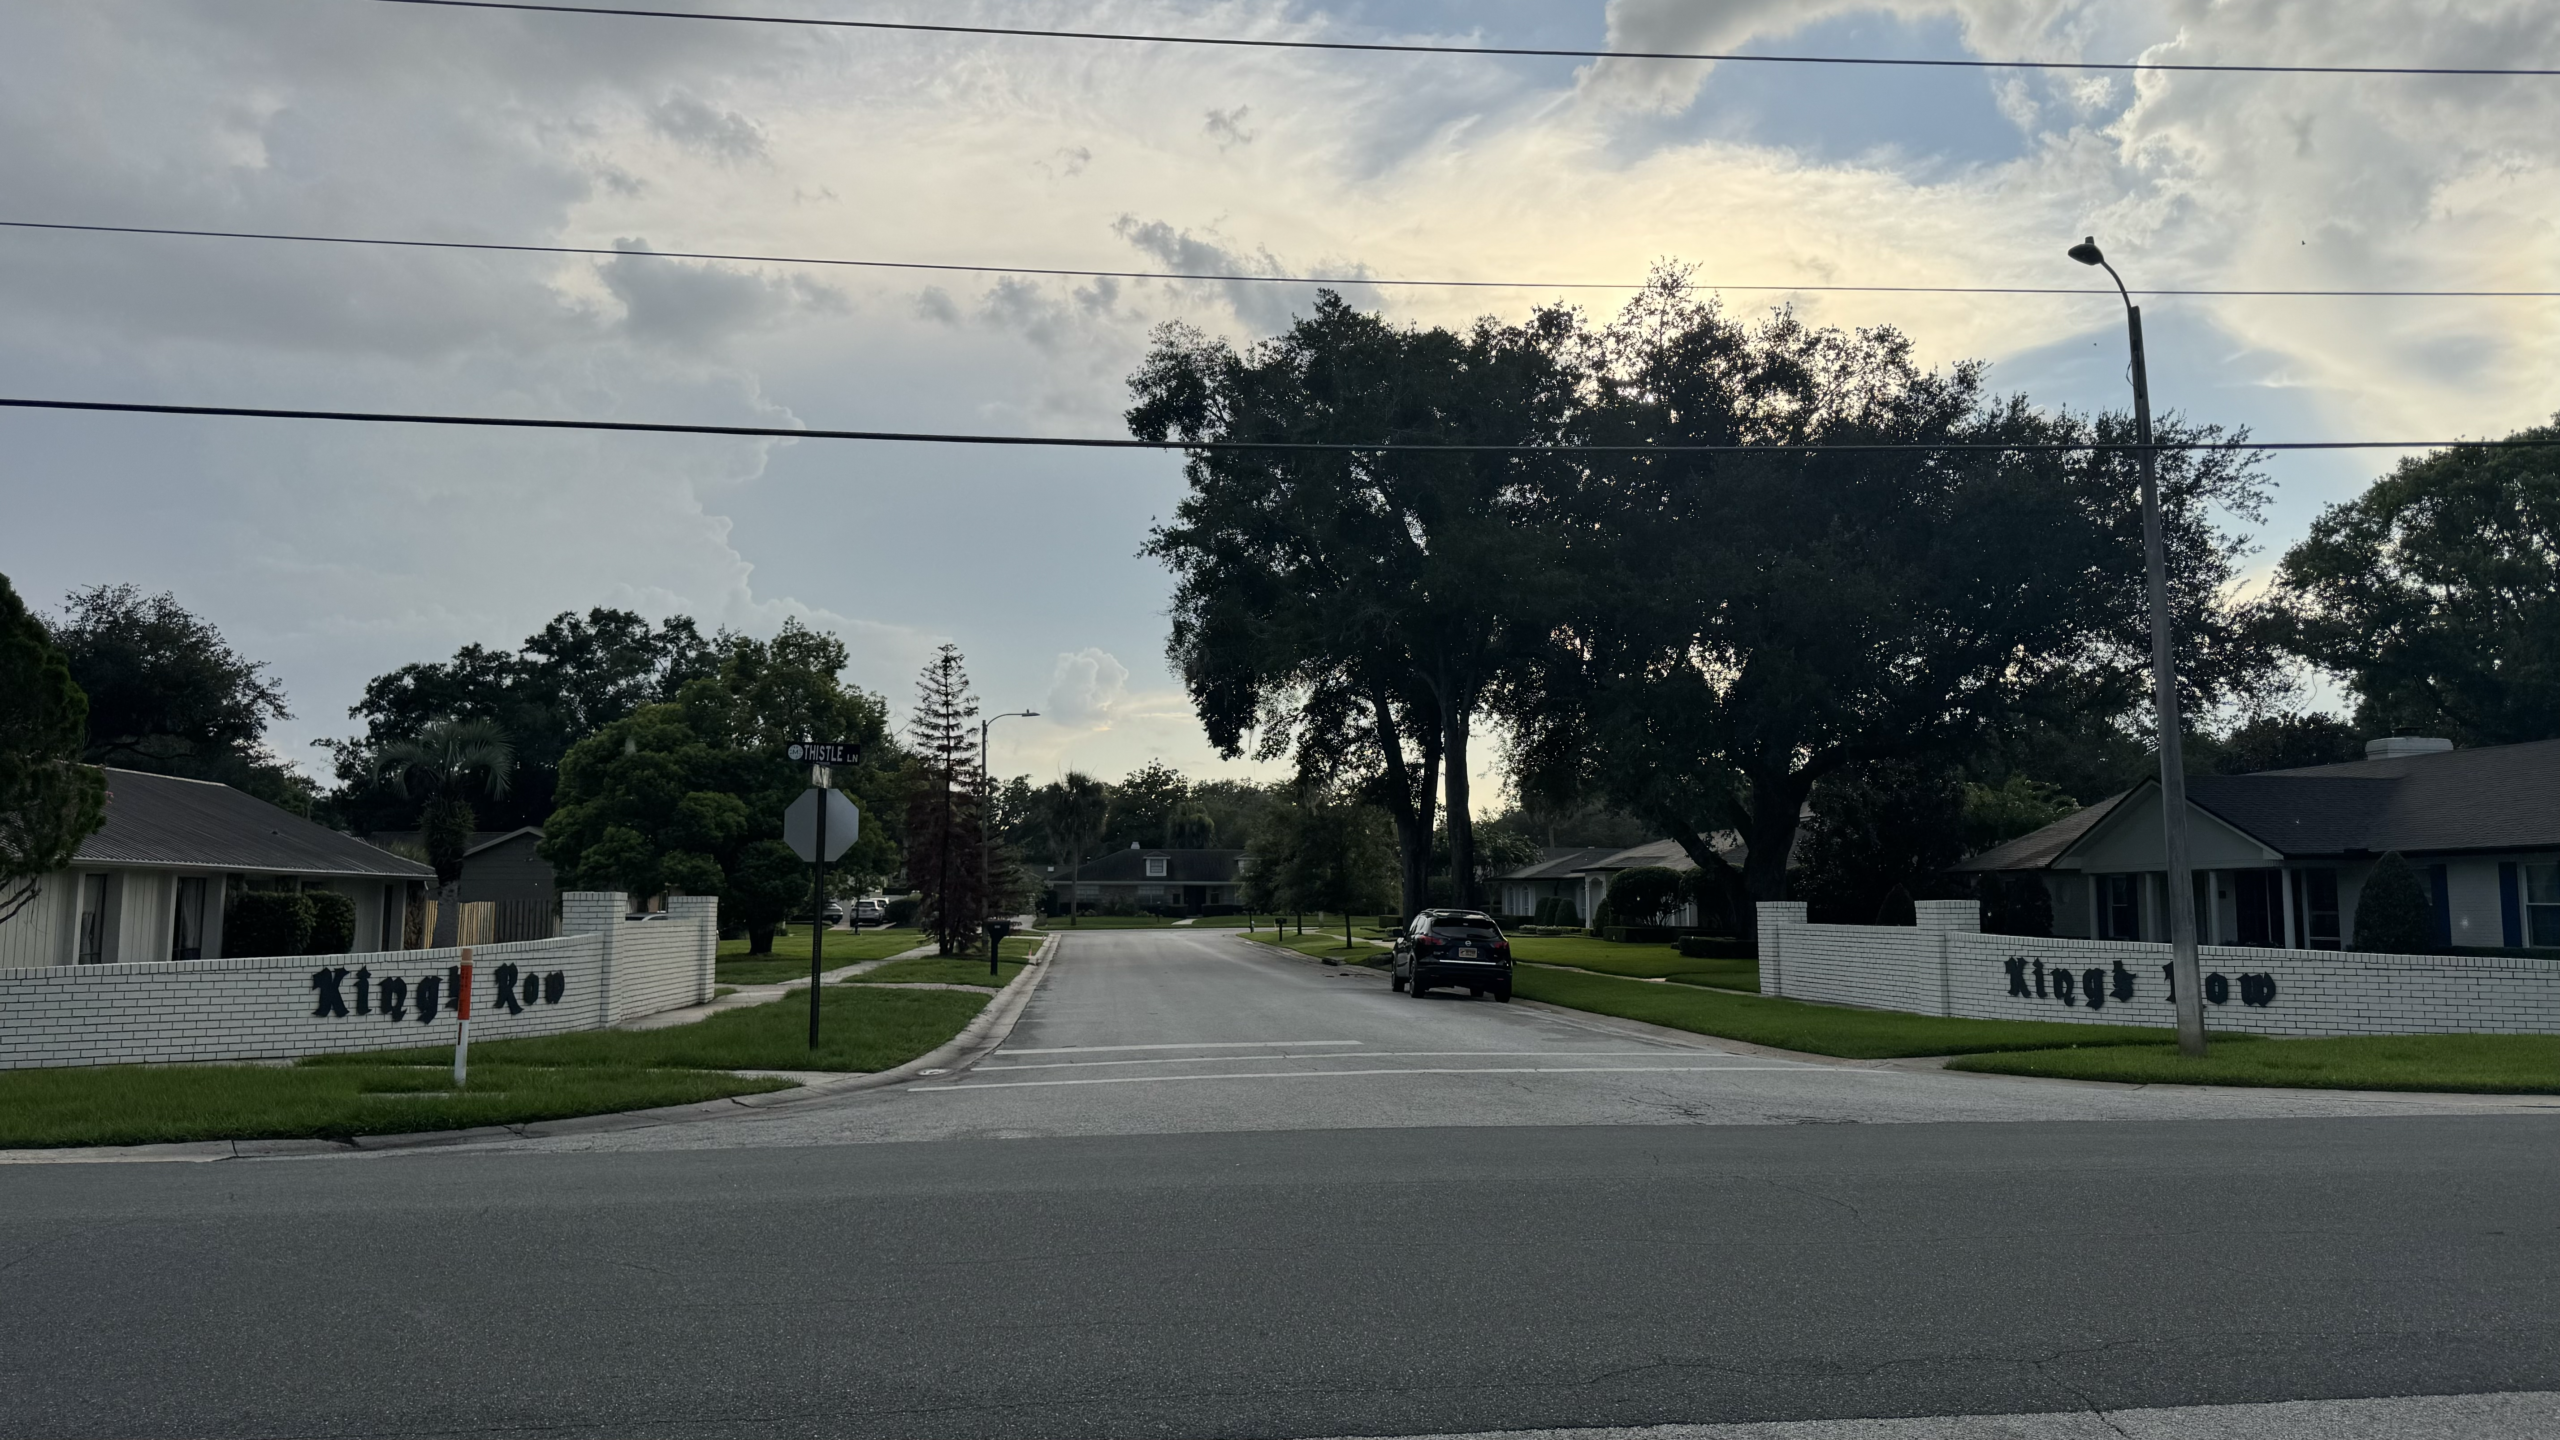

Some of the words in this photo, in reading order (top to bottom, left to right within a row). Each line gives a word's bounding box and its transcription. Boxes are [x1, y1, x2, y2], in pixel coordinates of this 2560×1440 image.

[804, 744, 843, 762] THISTLE
[847, 754, 858, 762] LN
[494, 962, 565, 1015] Row
